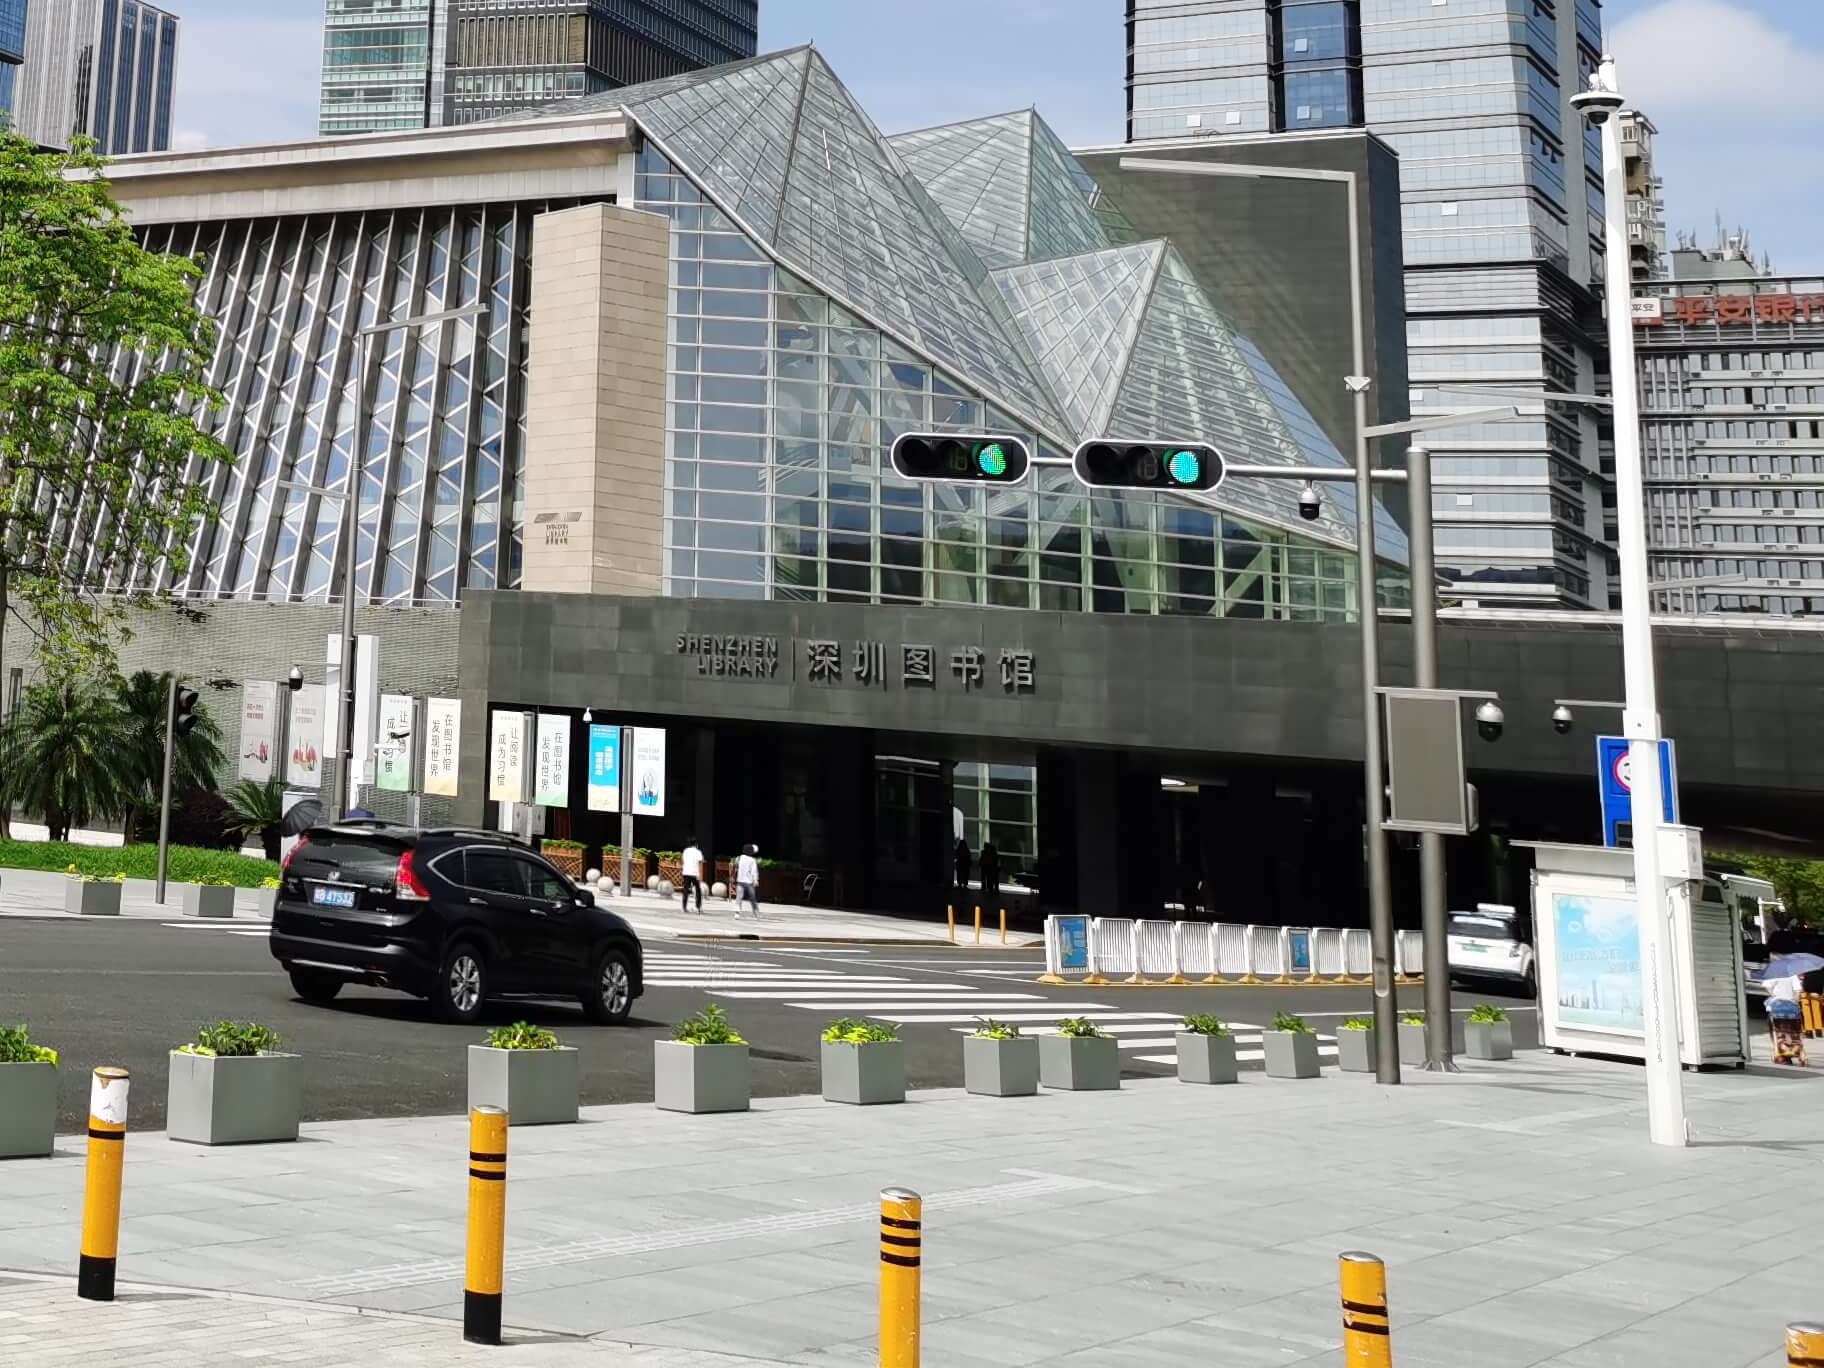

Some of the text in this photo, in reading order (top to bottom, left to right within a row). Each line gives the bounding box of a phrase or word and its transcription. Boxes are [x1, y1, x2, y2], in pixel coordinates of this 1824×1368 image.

[676, 633, 777, 655] SHENZHEN
[697, 654, 777, 675] LIBRARY
[807, 639, 1036, 691] 深圳图书馆
